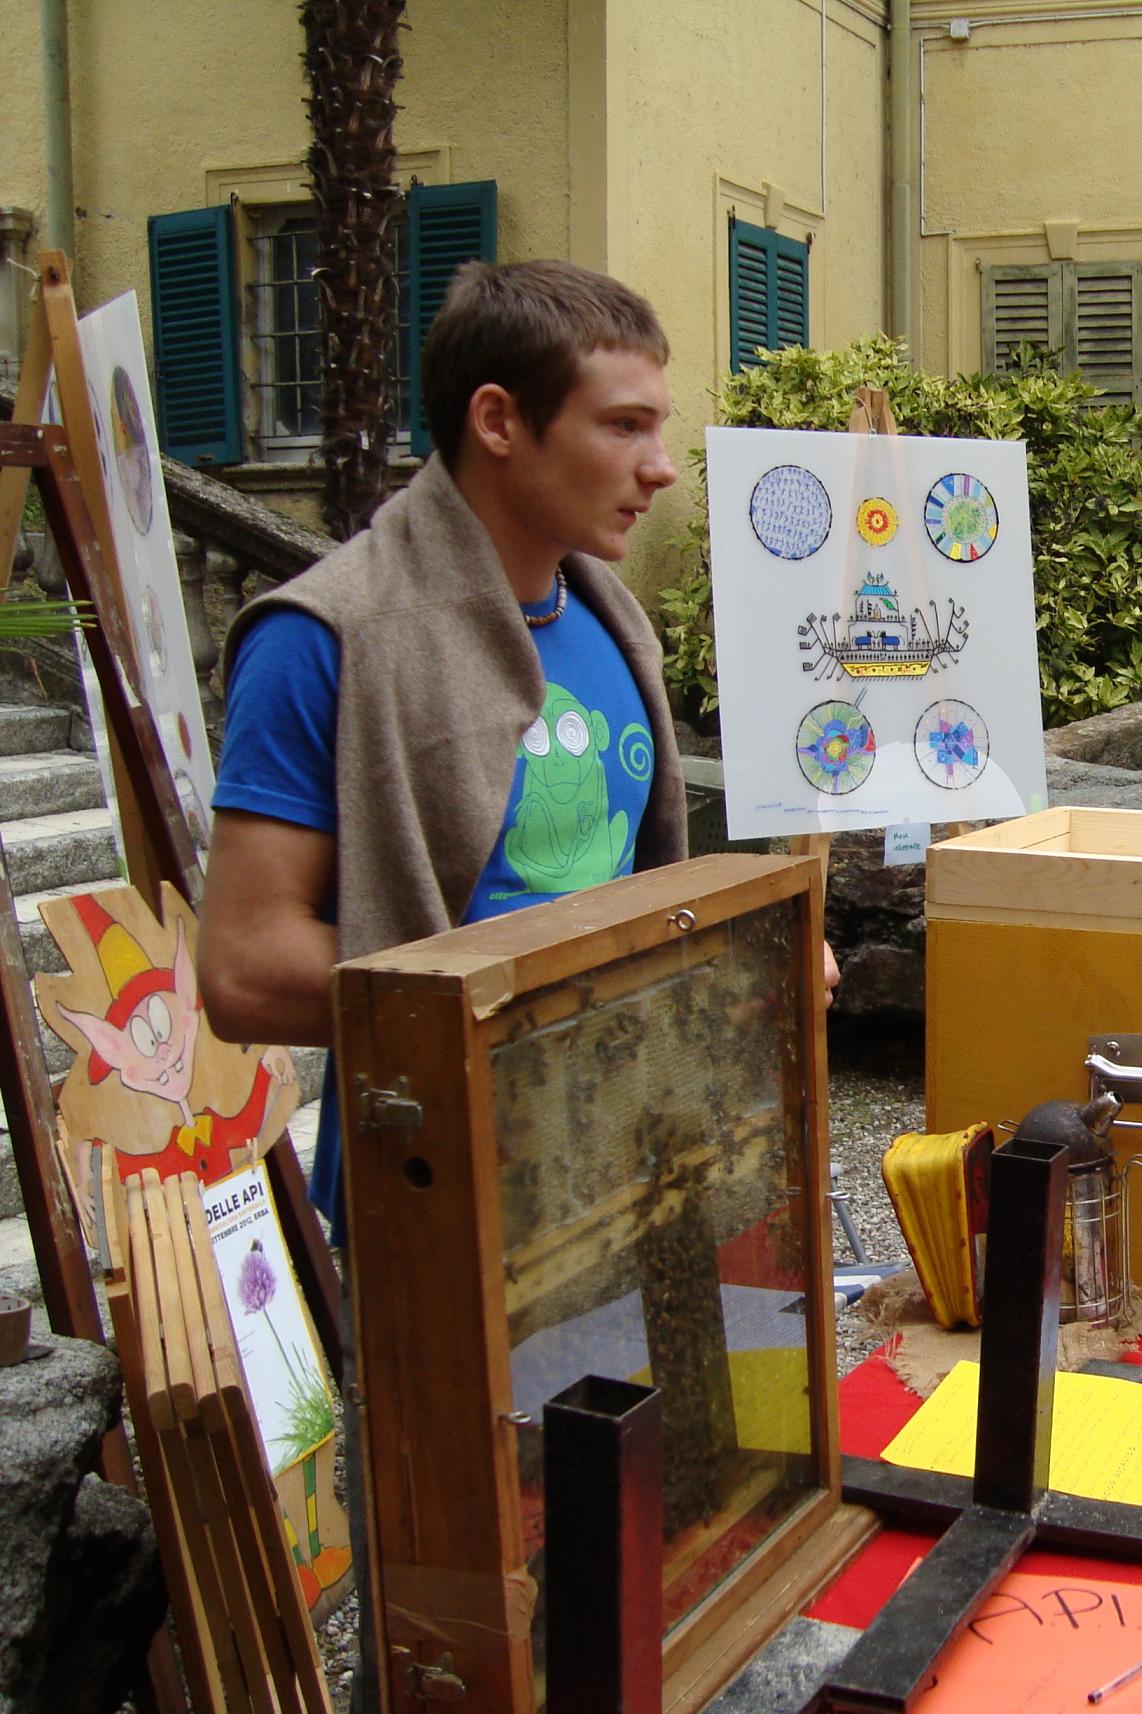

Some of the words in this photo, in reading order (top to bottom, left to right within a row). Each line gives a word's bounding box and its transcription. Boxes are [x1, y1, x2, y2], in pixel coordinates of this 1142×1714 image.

[205, 1193, 241, 1225] DELLE
[243, 1181, 264, 1205] API
[967, 1587, 1126, 1645] API
